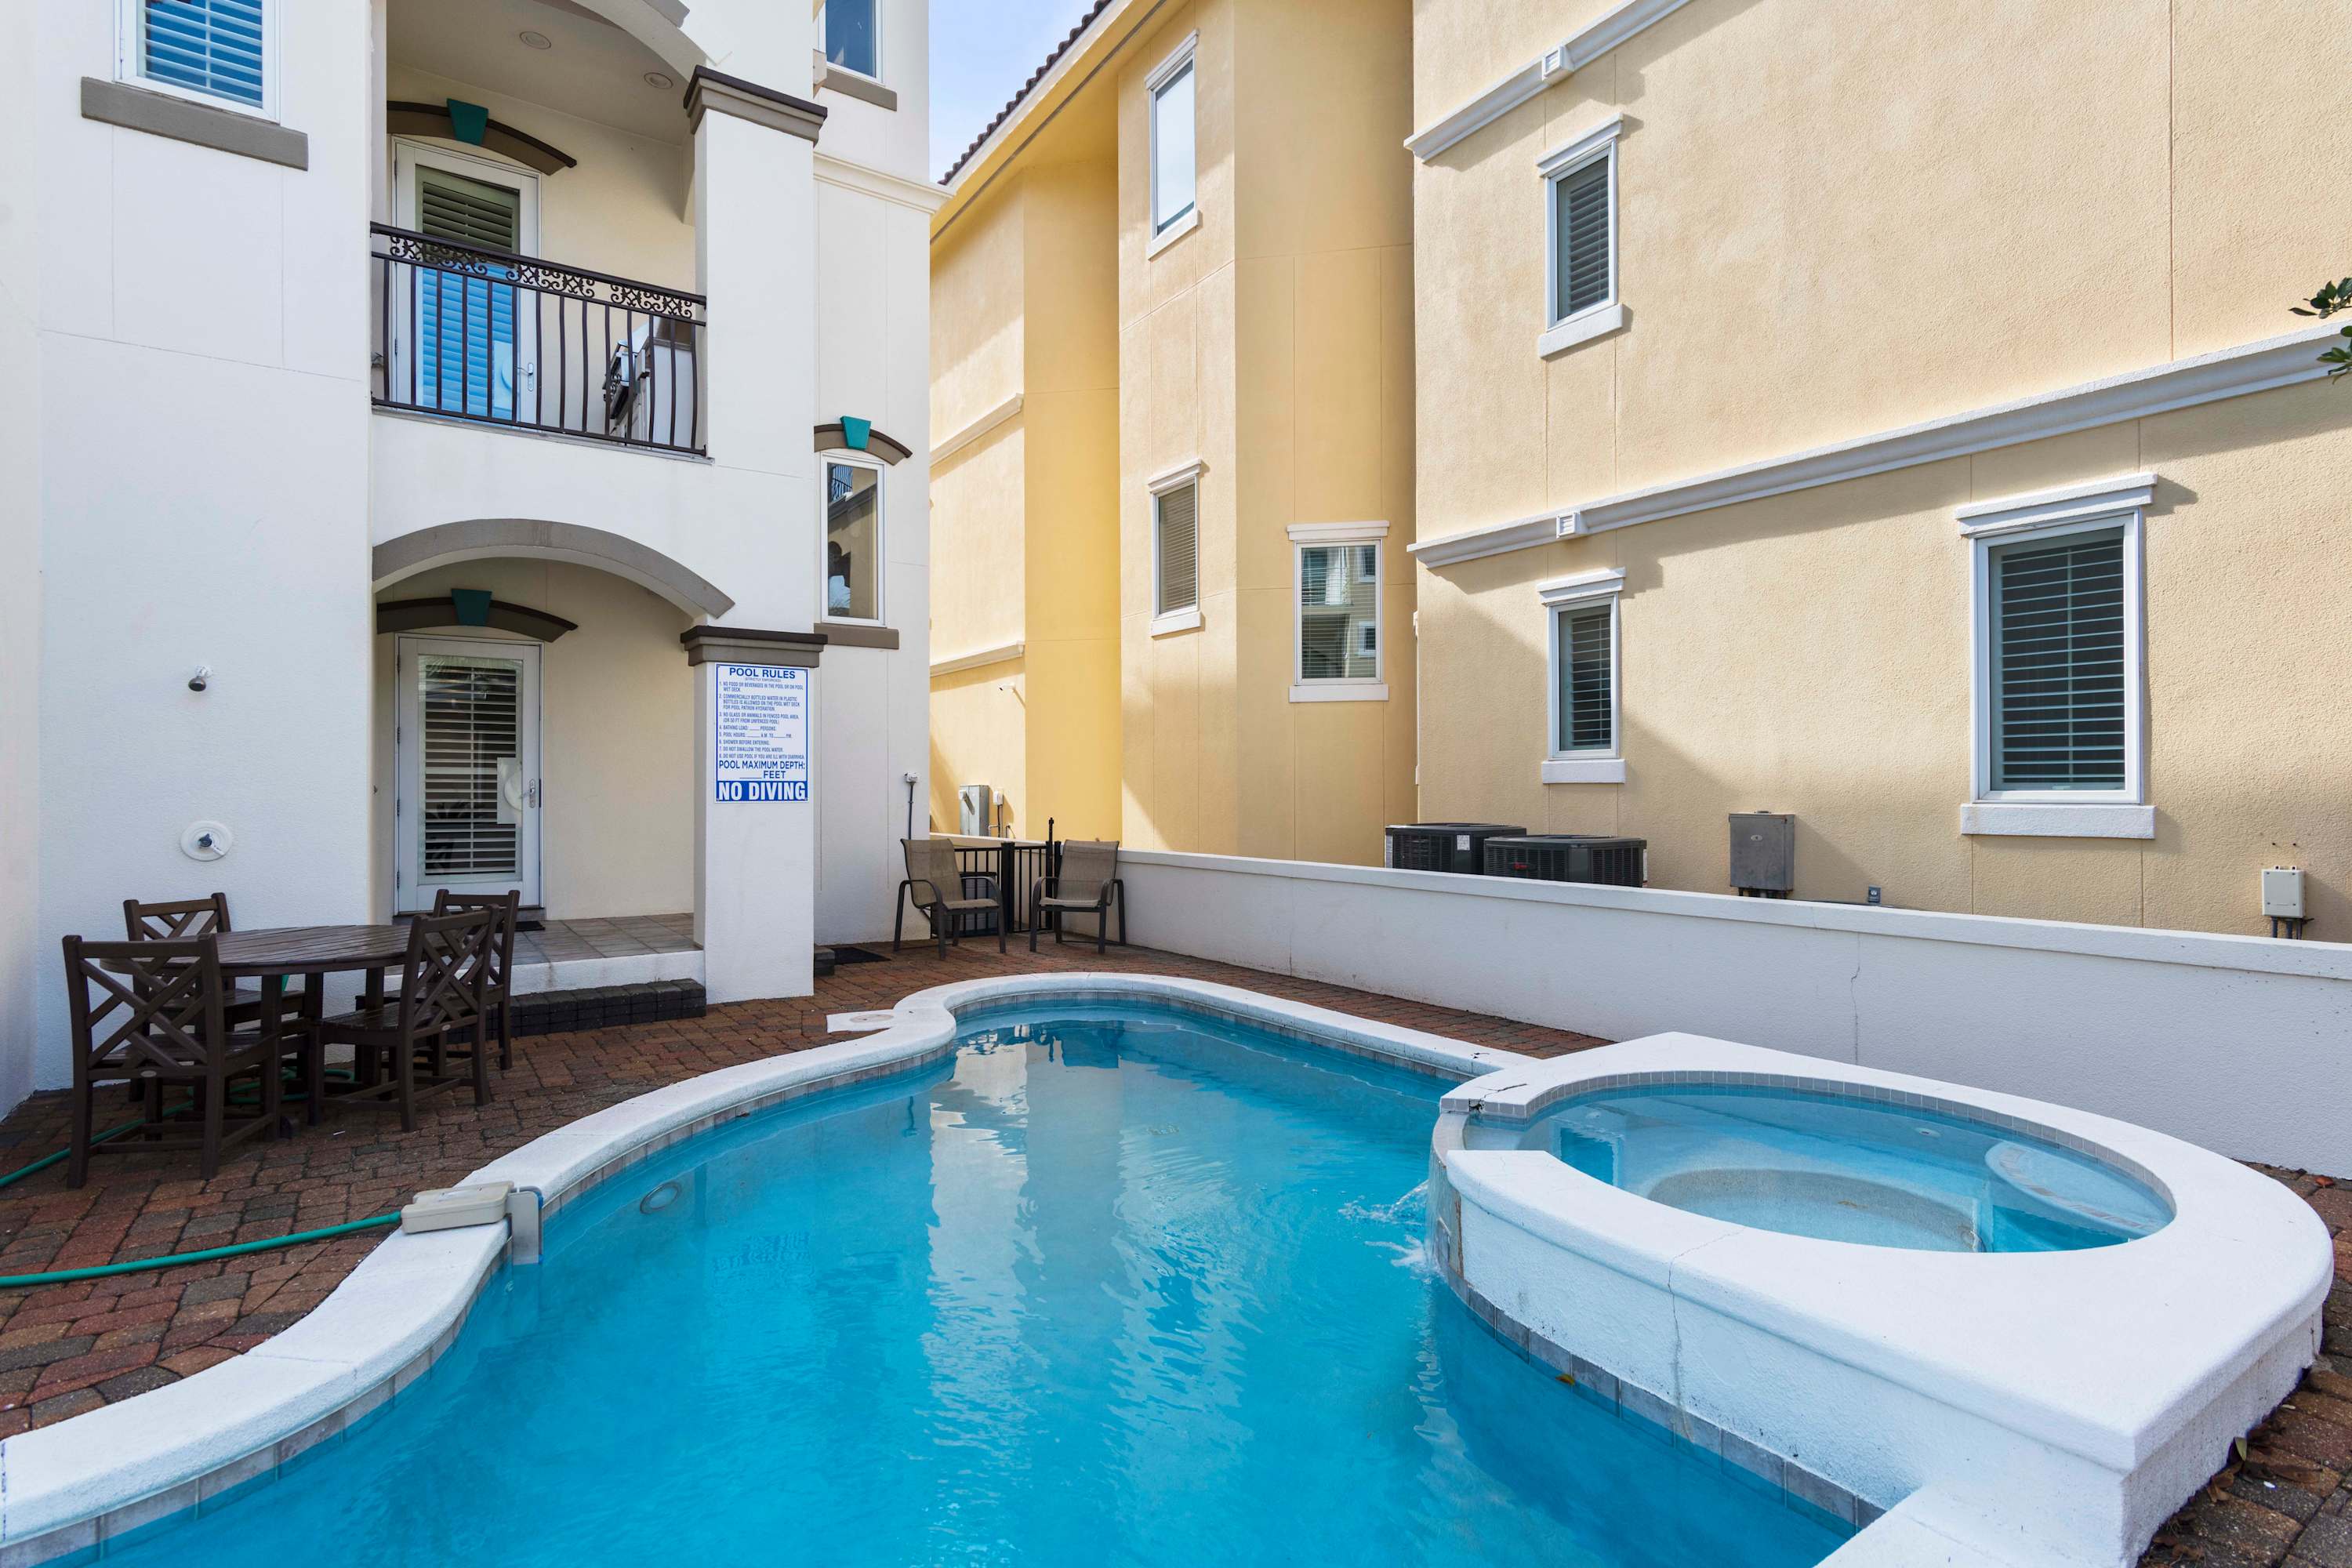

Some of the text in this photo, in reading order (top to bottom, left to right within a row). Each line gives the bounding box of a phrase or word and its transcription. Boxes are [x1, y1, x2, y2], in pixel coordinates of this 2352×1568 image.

[730, 668, 795, 679] POOL RULES
[719, 760, 740, 768] POOL
[719, 782, 805, 800] NO DIVING
